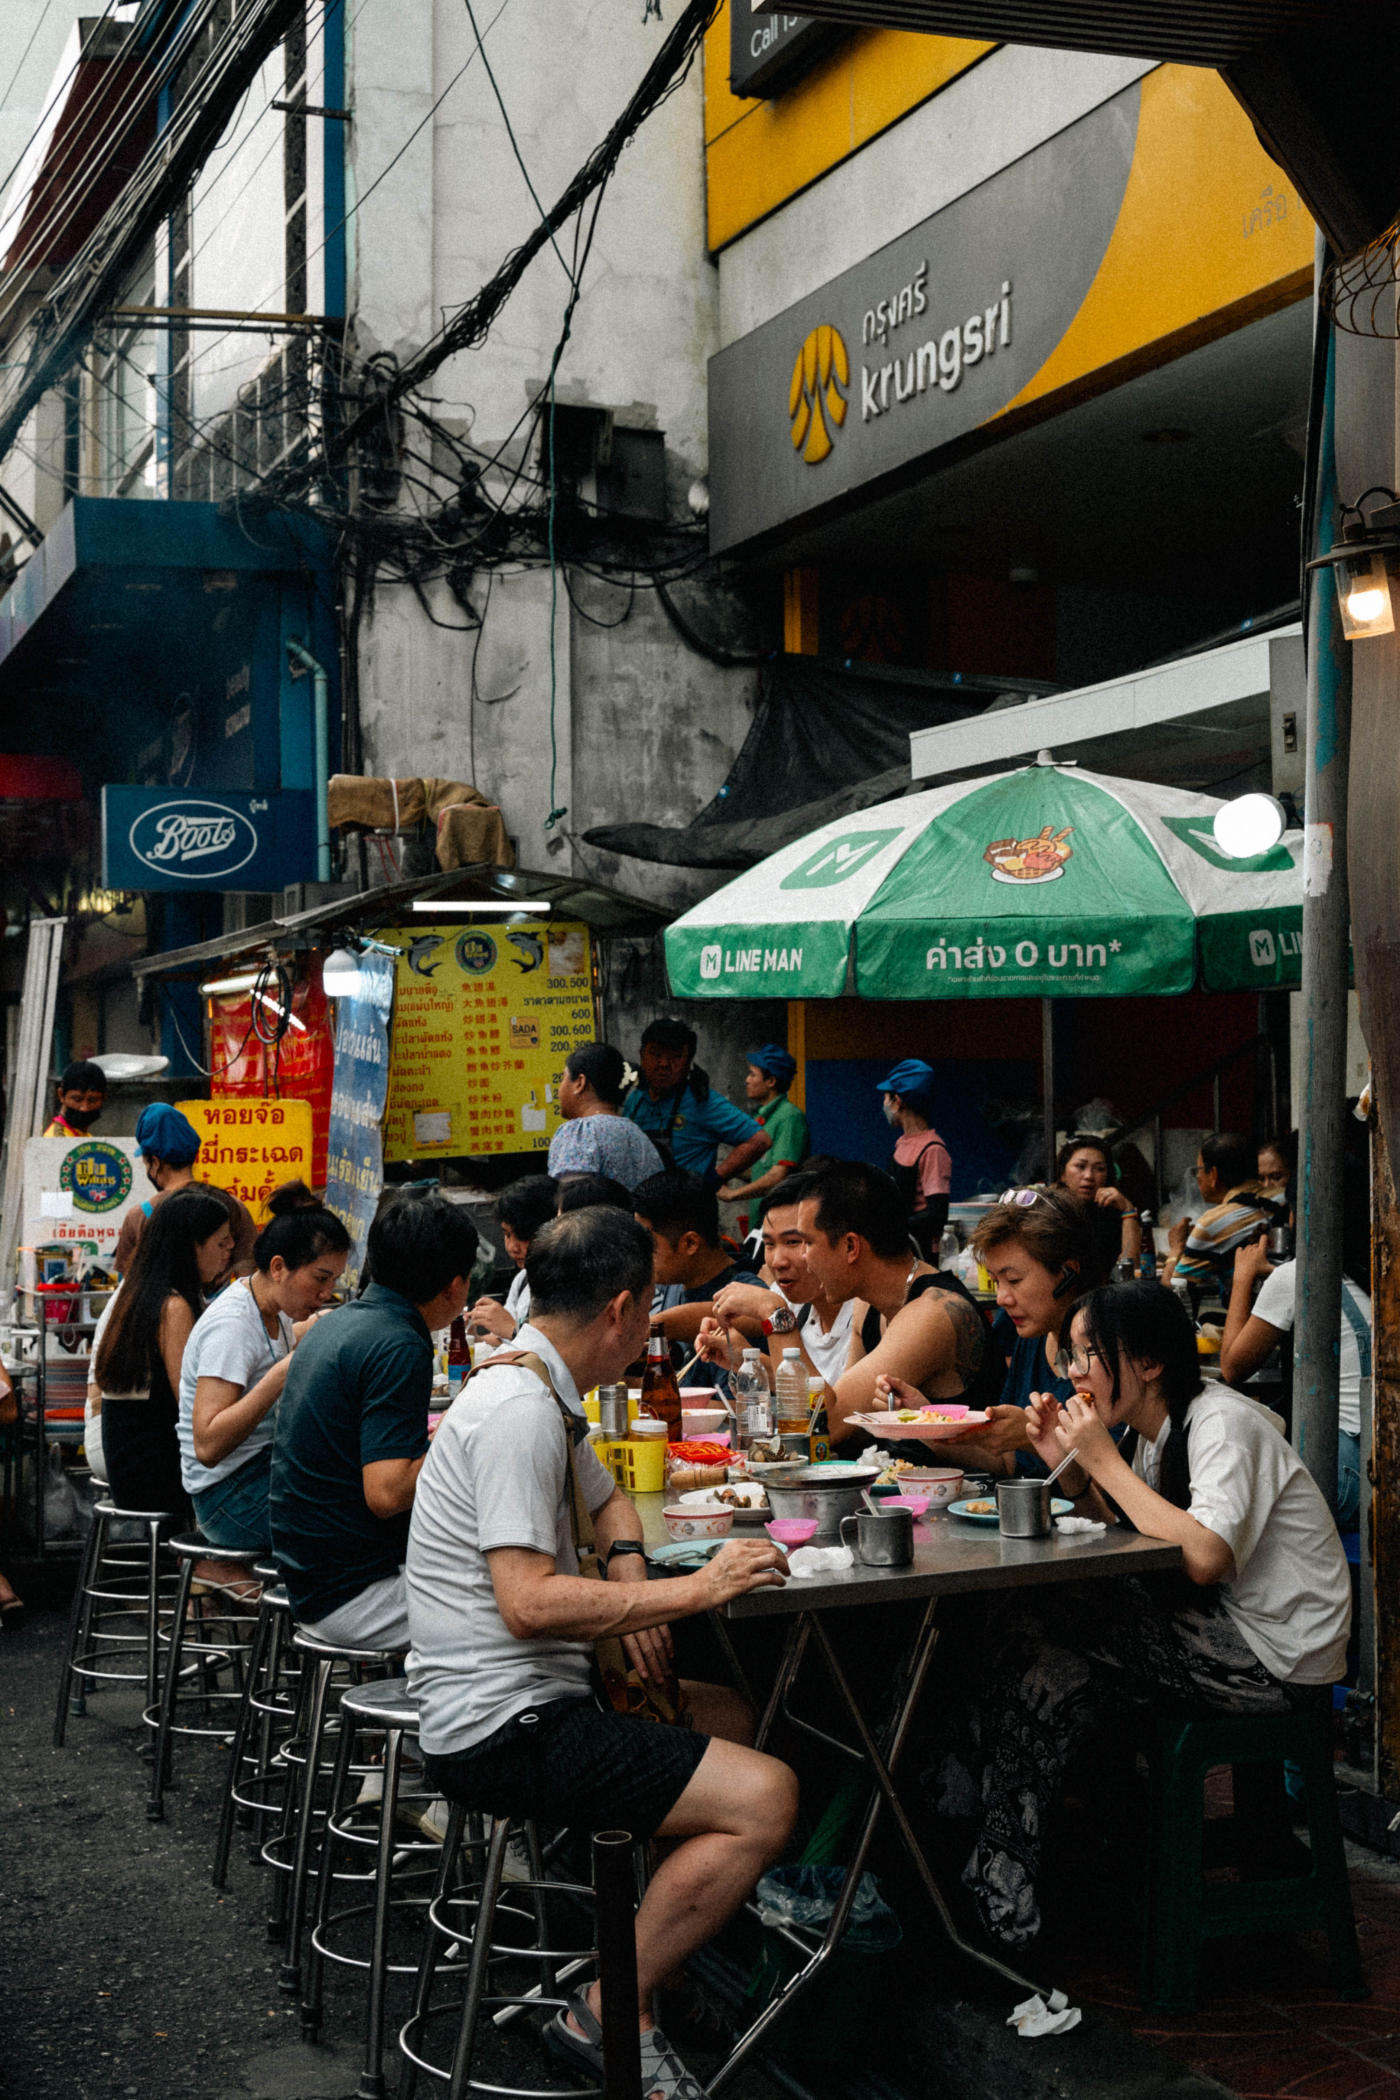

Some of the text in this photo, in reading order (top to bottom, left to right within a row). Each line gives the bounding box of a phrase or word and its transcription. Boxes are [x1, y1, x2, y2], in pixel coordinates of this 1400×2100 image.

[750, 14, 778, 57] Call
[862, 259, 928, 345] กรุงศรี
[861, 280, 1011, 421] krungsri
[145, 813, 237, 861] Boots
[724, 949, 762, 973] LINE
[763, 948, 804, 972] MAN
[926, 936, 1007, 970] ค่าส่ง
[571, 1009, 591, 1019] 600
[203, 1101, 285, 1125] หอยจ๊อ
